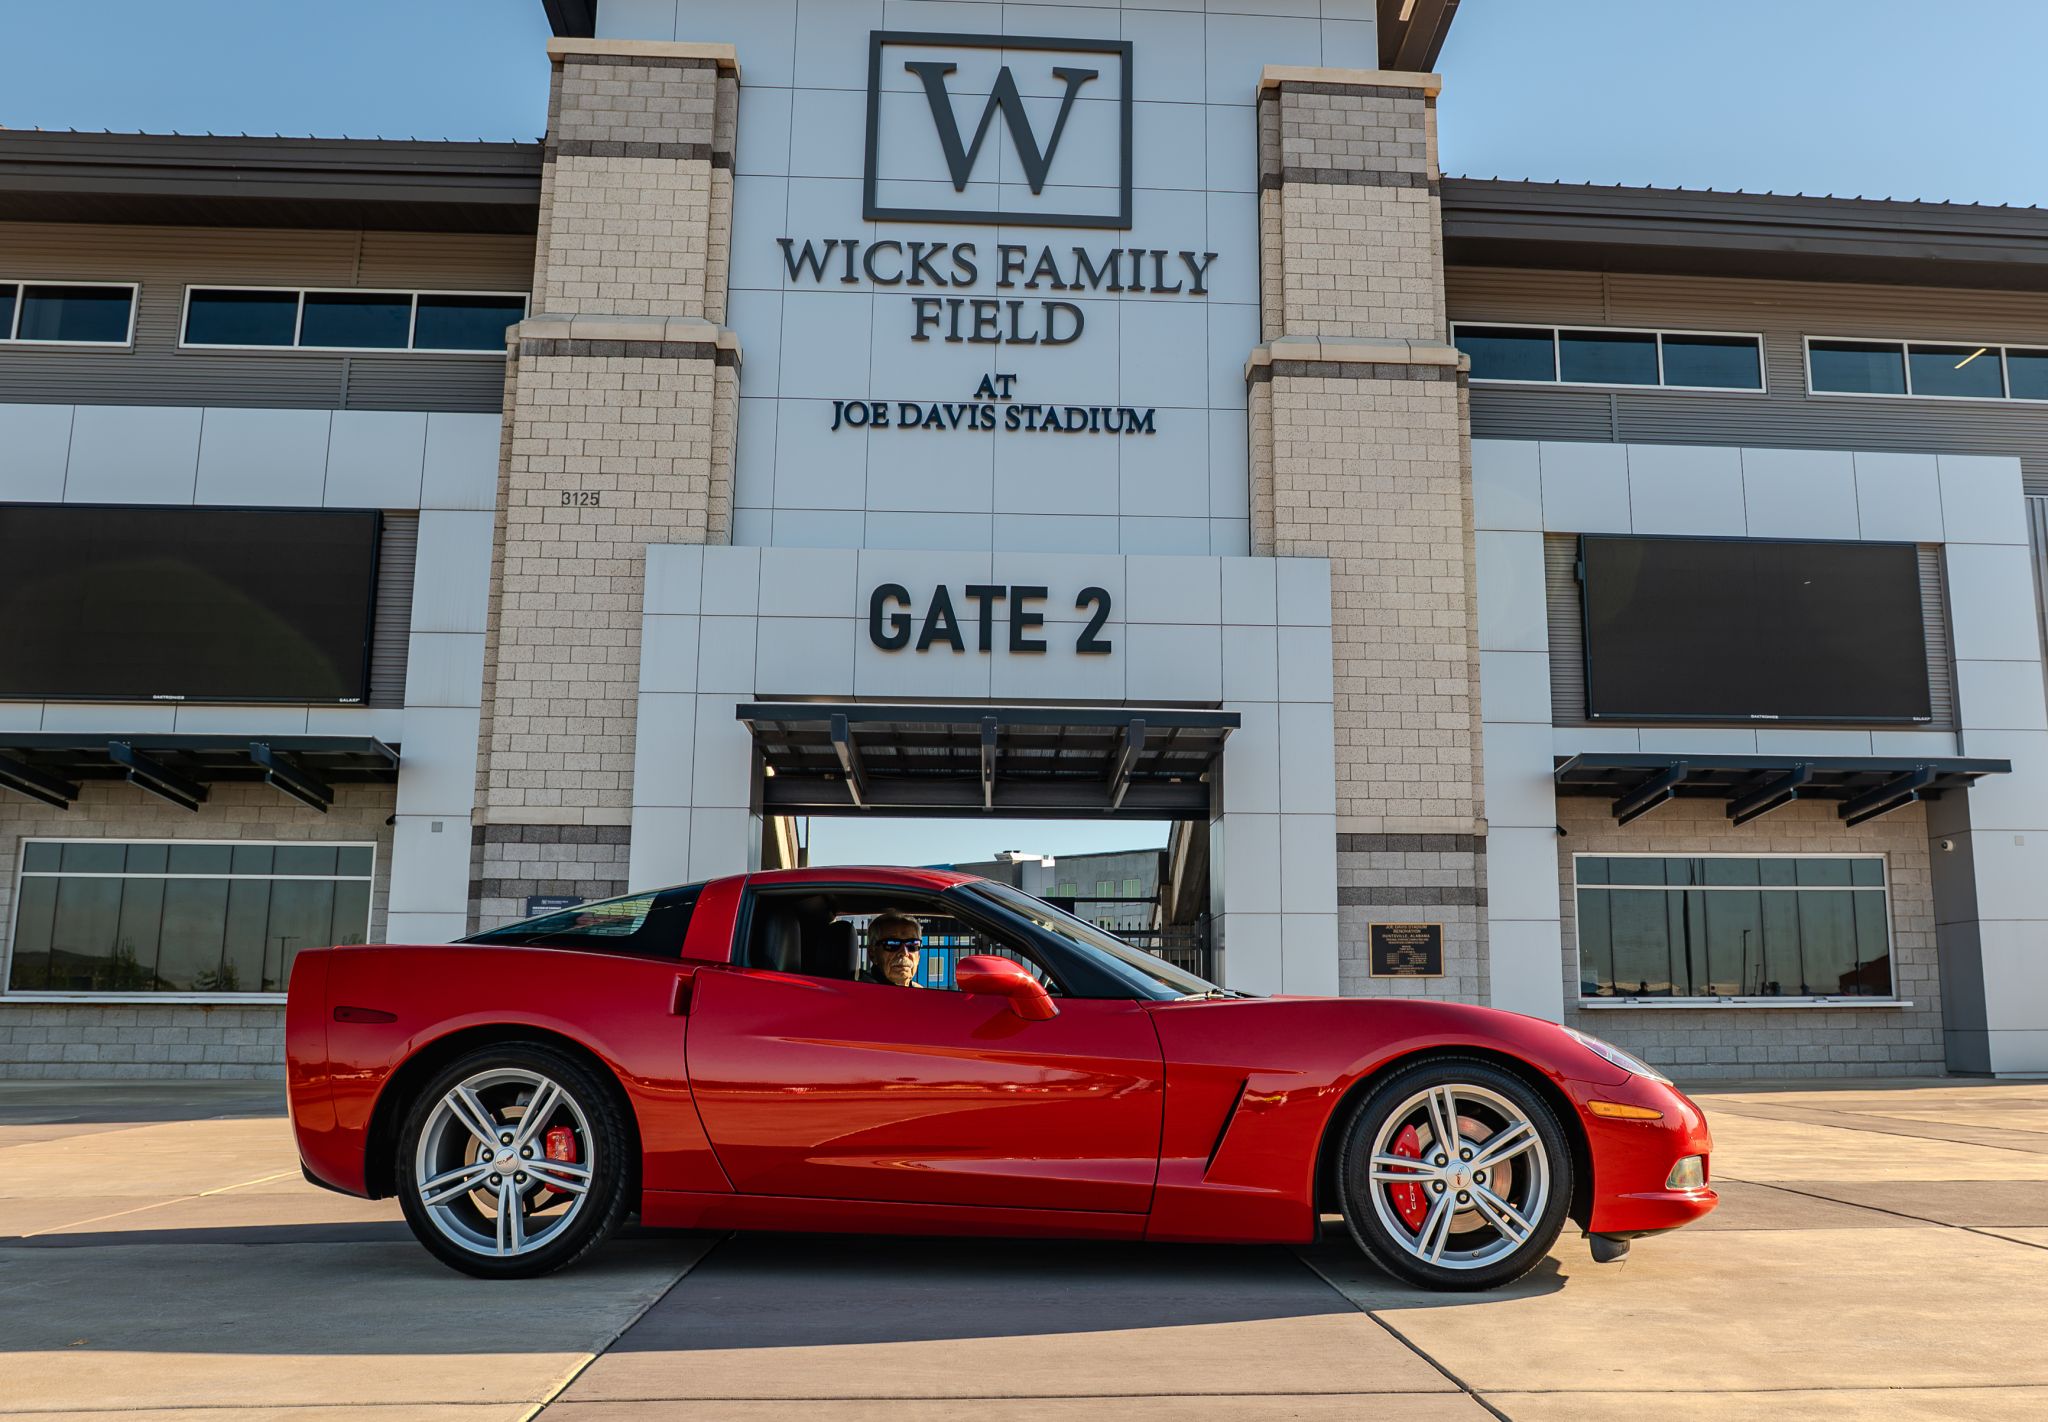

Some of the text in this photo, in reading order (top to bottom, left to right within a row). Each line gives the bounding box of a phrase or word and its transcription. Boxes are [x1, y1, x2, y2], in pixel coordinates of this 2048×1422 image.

[904, 61, 1099, 196] W
[776, 238, 1219, 295] WICKS FAMILY
[910, 298, 1085, 345] FIELD
[973, 373, 1017, 399] AT
[831, 401, 1157, 435] JOE DAVIS STADIUM
[562, 492, 599, 506] 3125
[869, 583, 1112, 655] GATE 2
